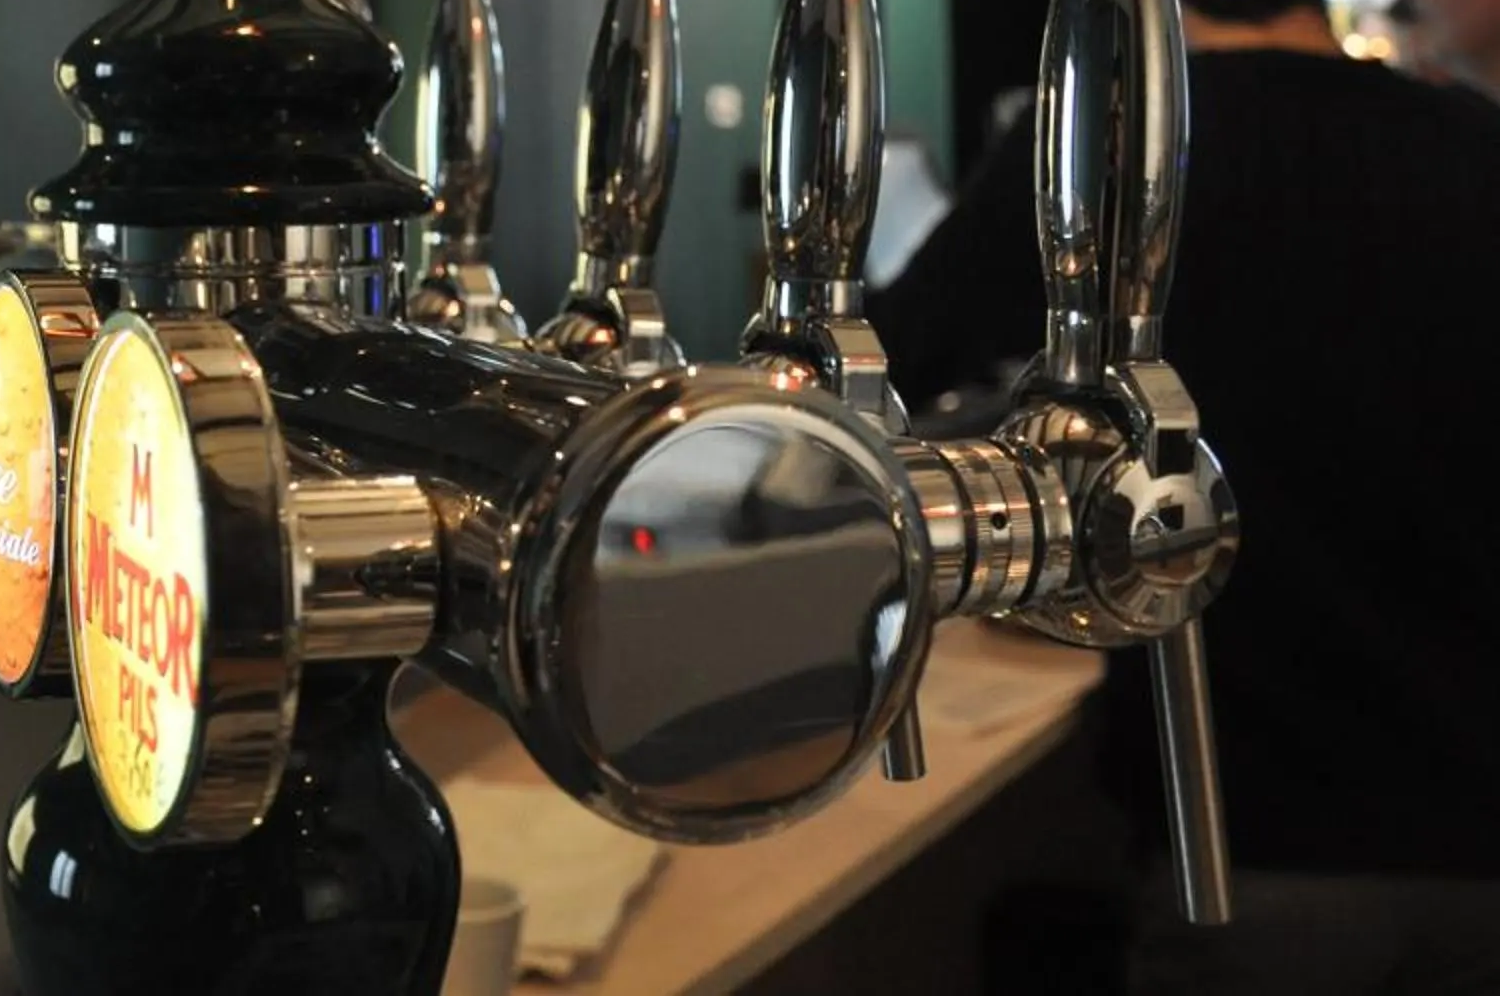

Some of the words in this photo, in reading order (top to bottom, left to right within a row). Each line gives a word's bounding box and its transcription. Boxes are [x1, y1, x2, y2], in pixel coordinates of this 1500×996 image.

[130, 443, 153, 540] M
[85, 512, 198, 712] METEOR
[118, 663, 158, 754] PILS
